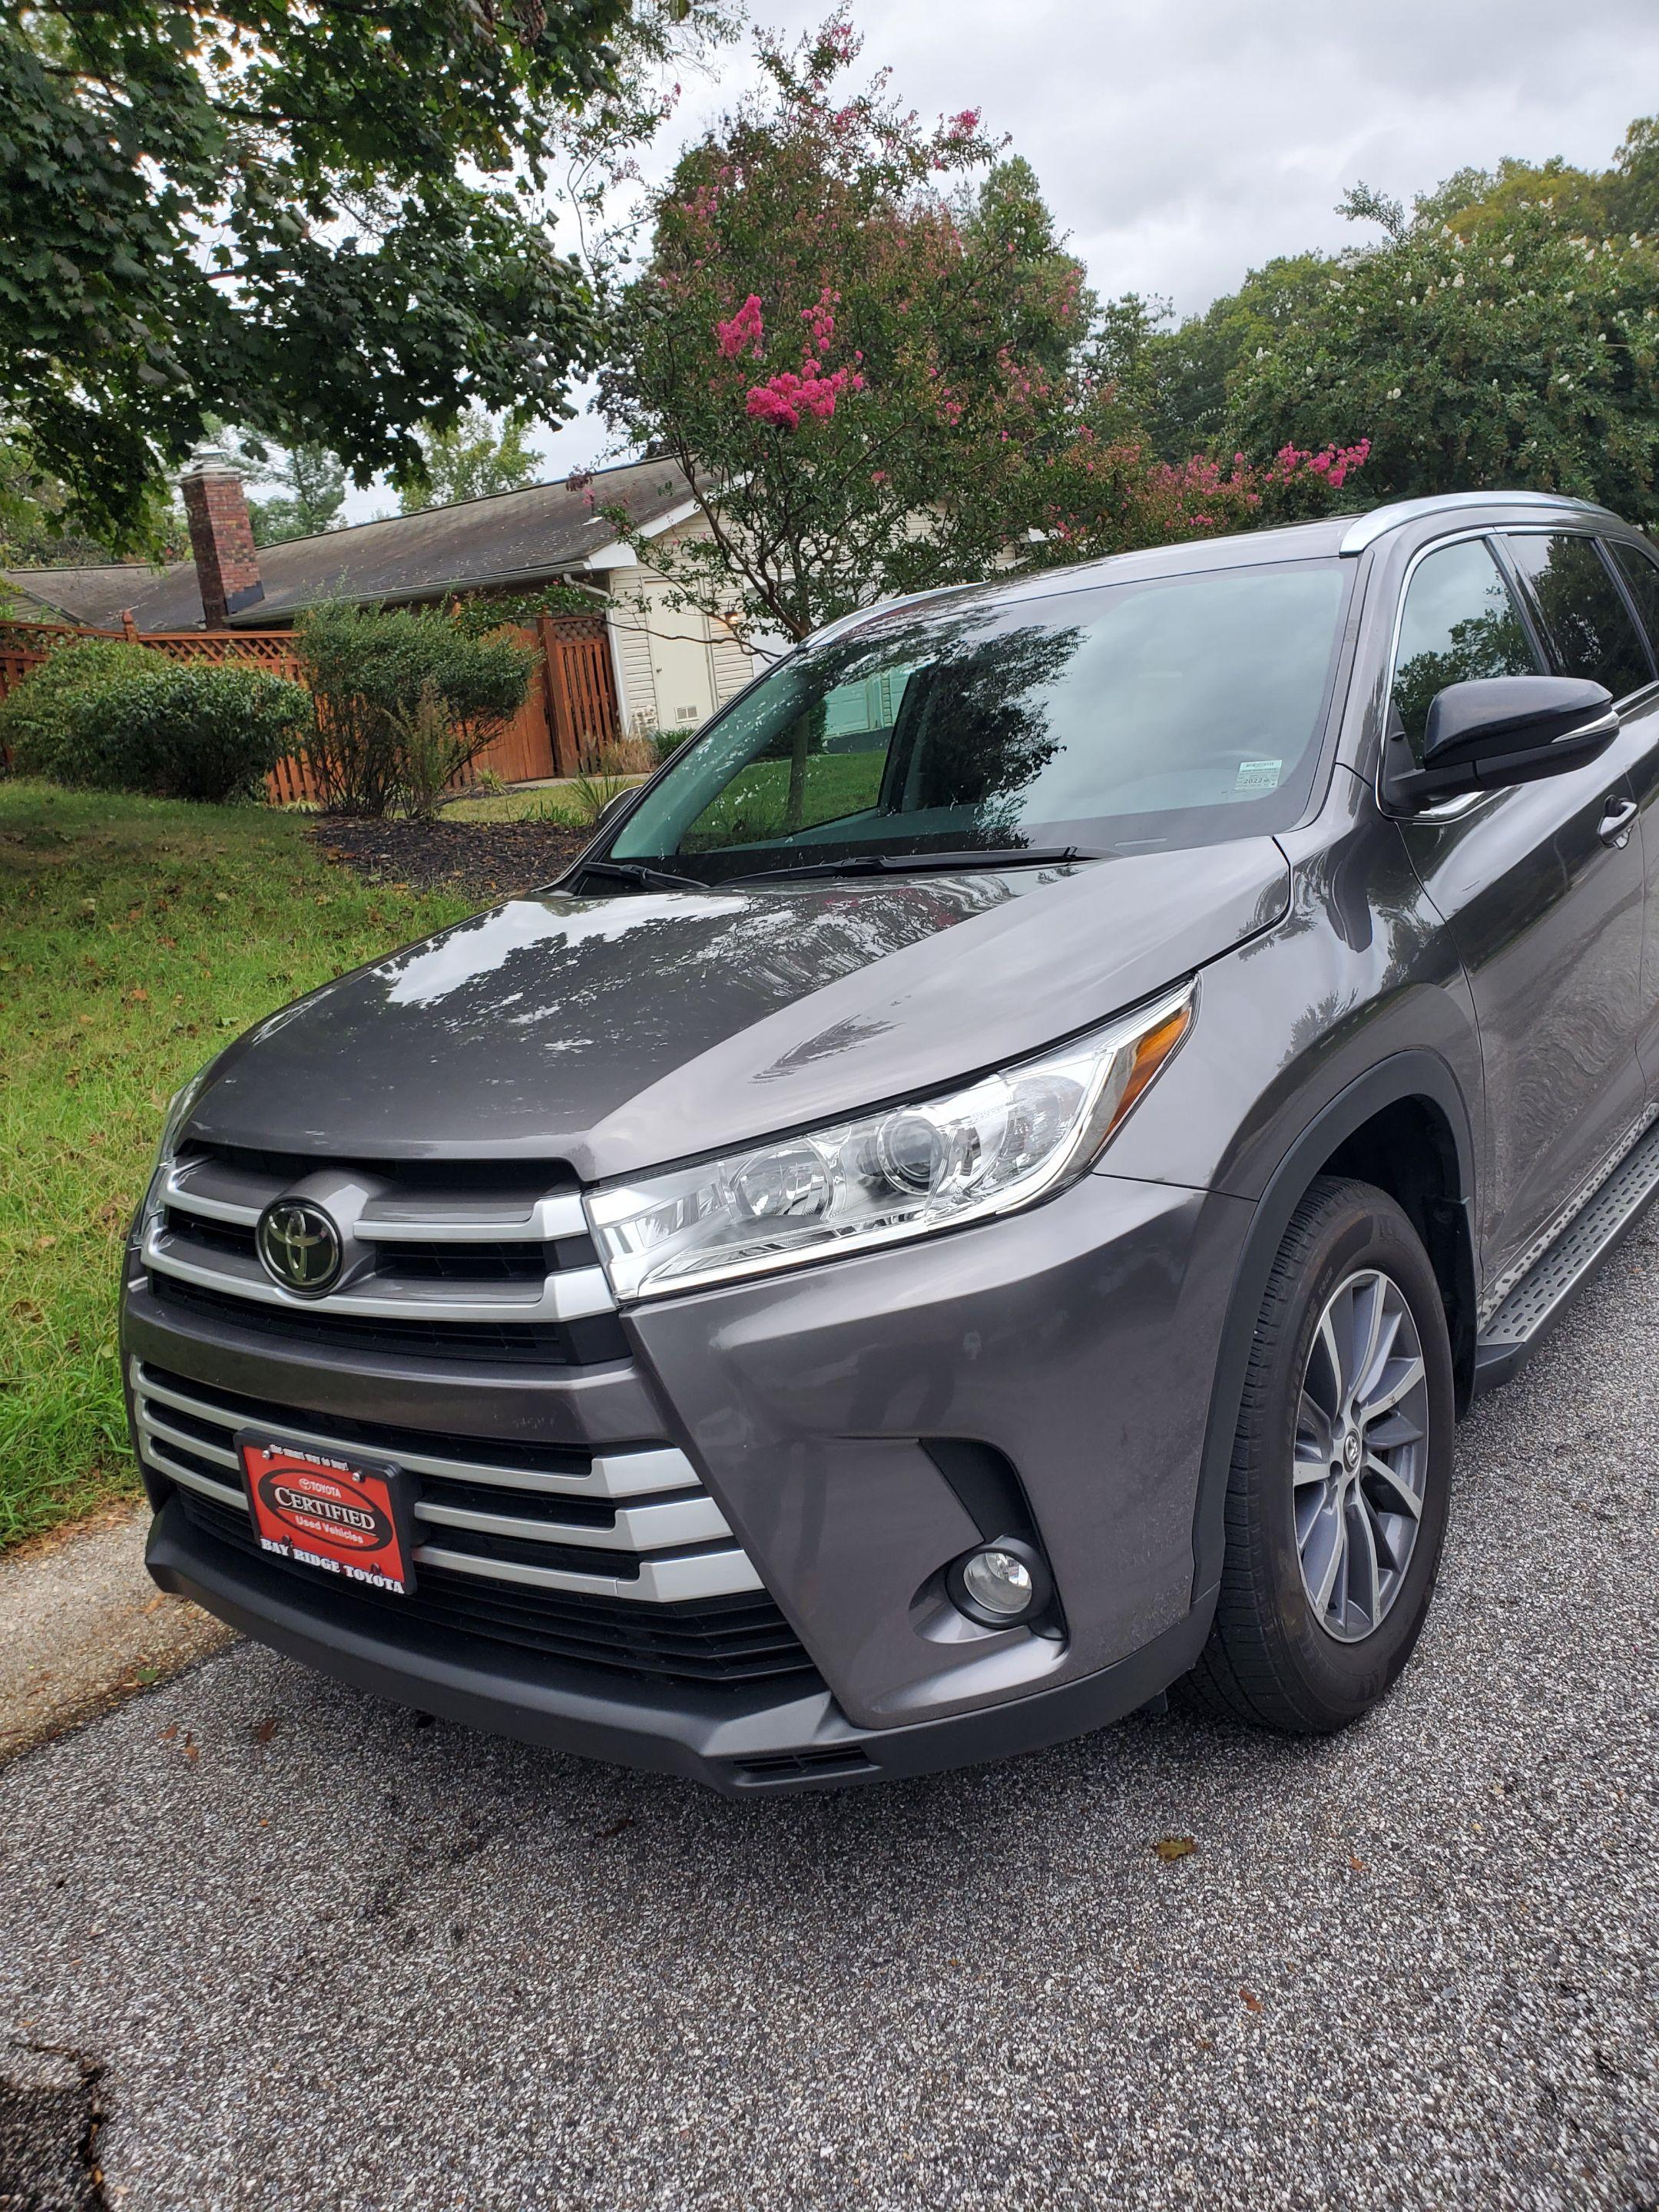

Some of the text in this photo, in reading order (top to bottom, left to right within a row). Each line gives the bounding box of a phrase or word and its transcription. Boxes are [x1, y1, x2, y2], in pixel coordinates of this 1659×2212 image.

[320, 1456, 331, 1467] to
[310, 1481, 342, 1498] TOYOTA
[294, 1515, 364, 1544] Used Vehicles
[260, 1538, 406, 1594] BAY RIDGE TOYOTA
